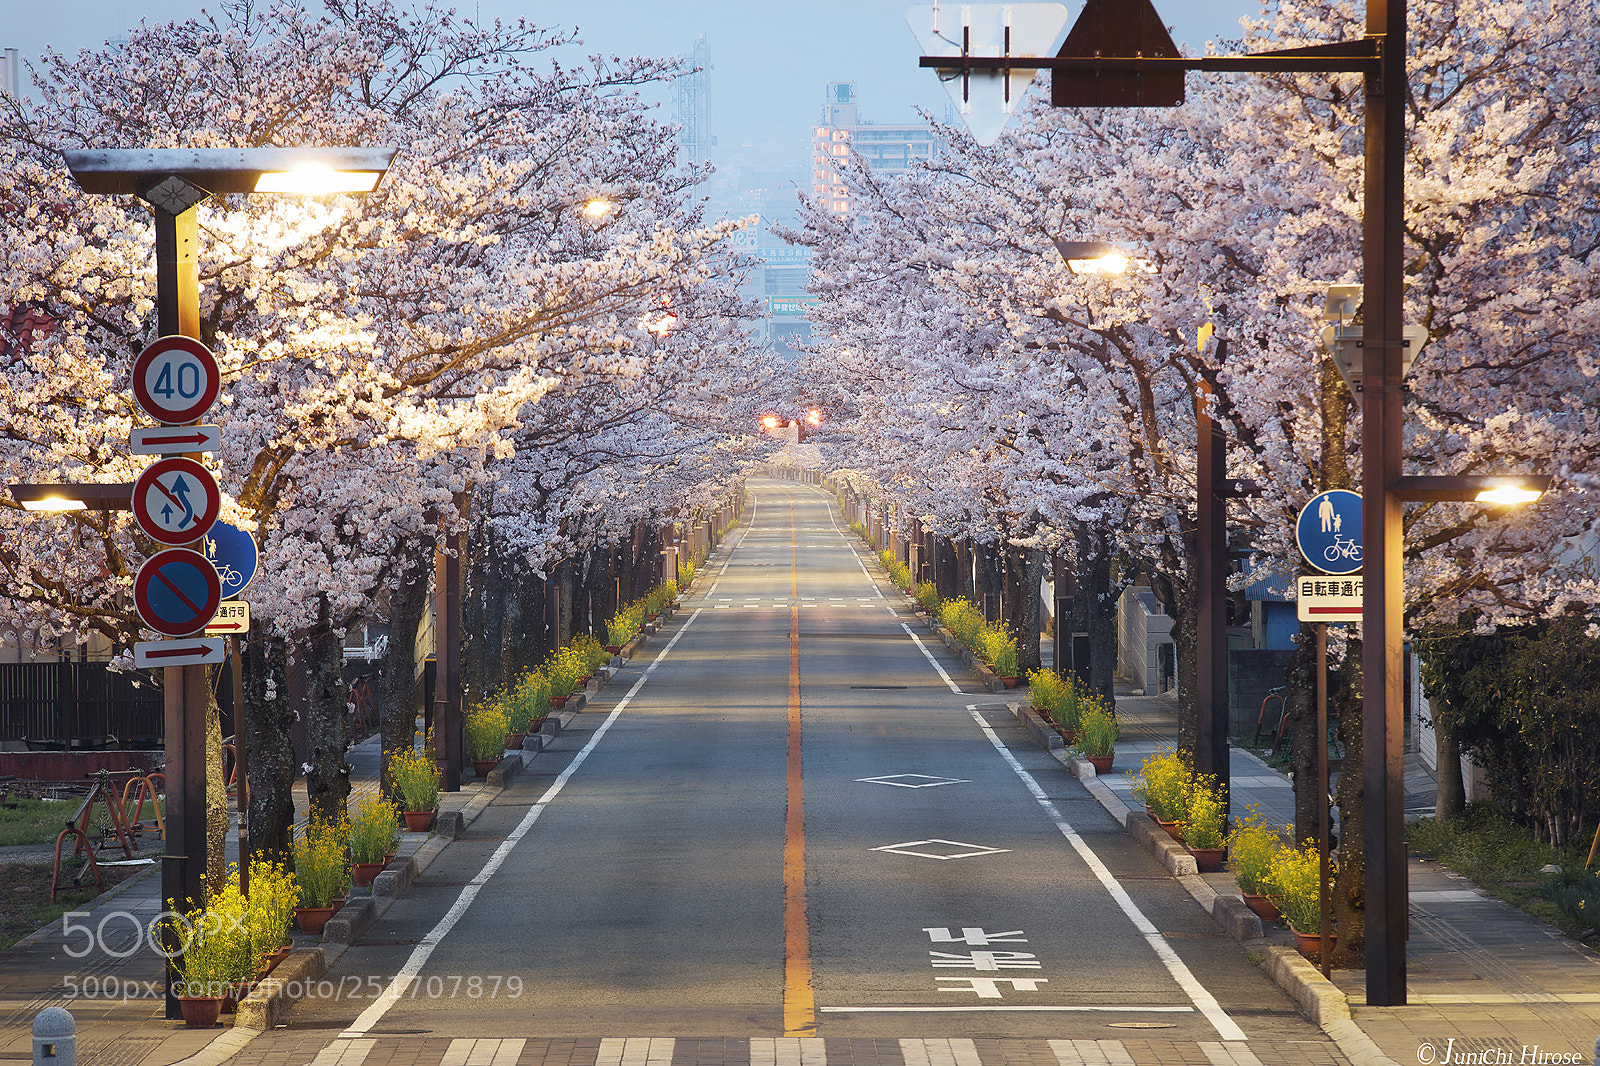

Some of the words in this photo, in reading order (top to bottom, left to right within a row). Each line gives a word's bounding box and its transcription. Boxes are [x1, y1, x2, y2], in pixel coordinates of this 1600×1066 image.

[153, 361, 201, 400] 40
[215, 606, 246, 618] 通行可
